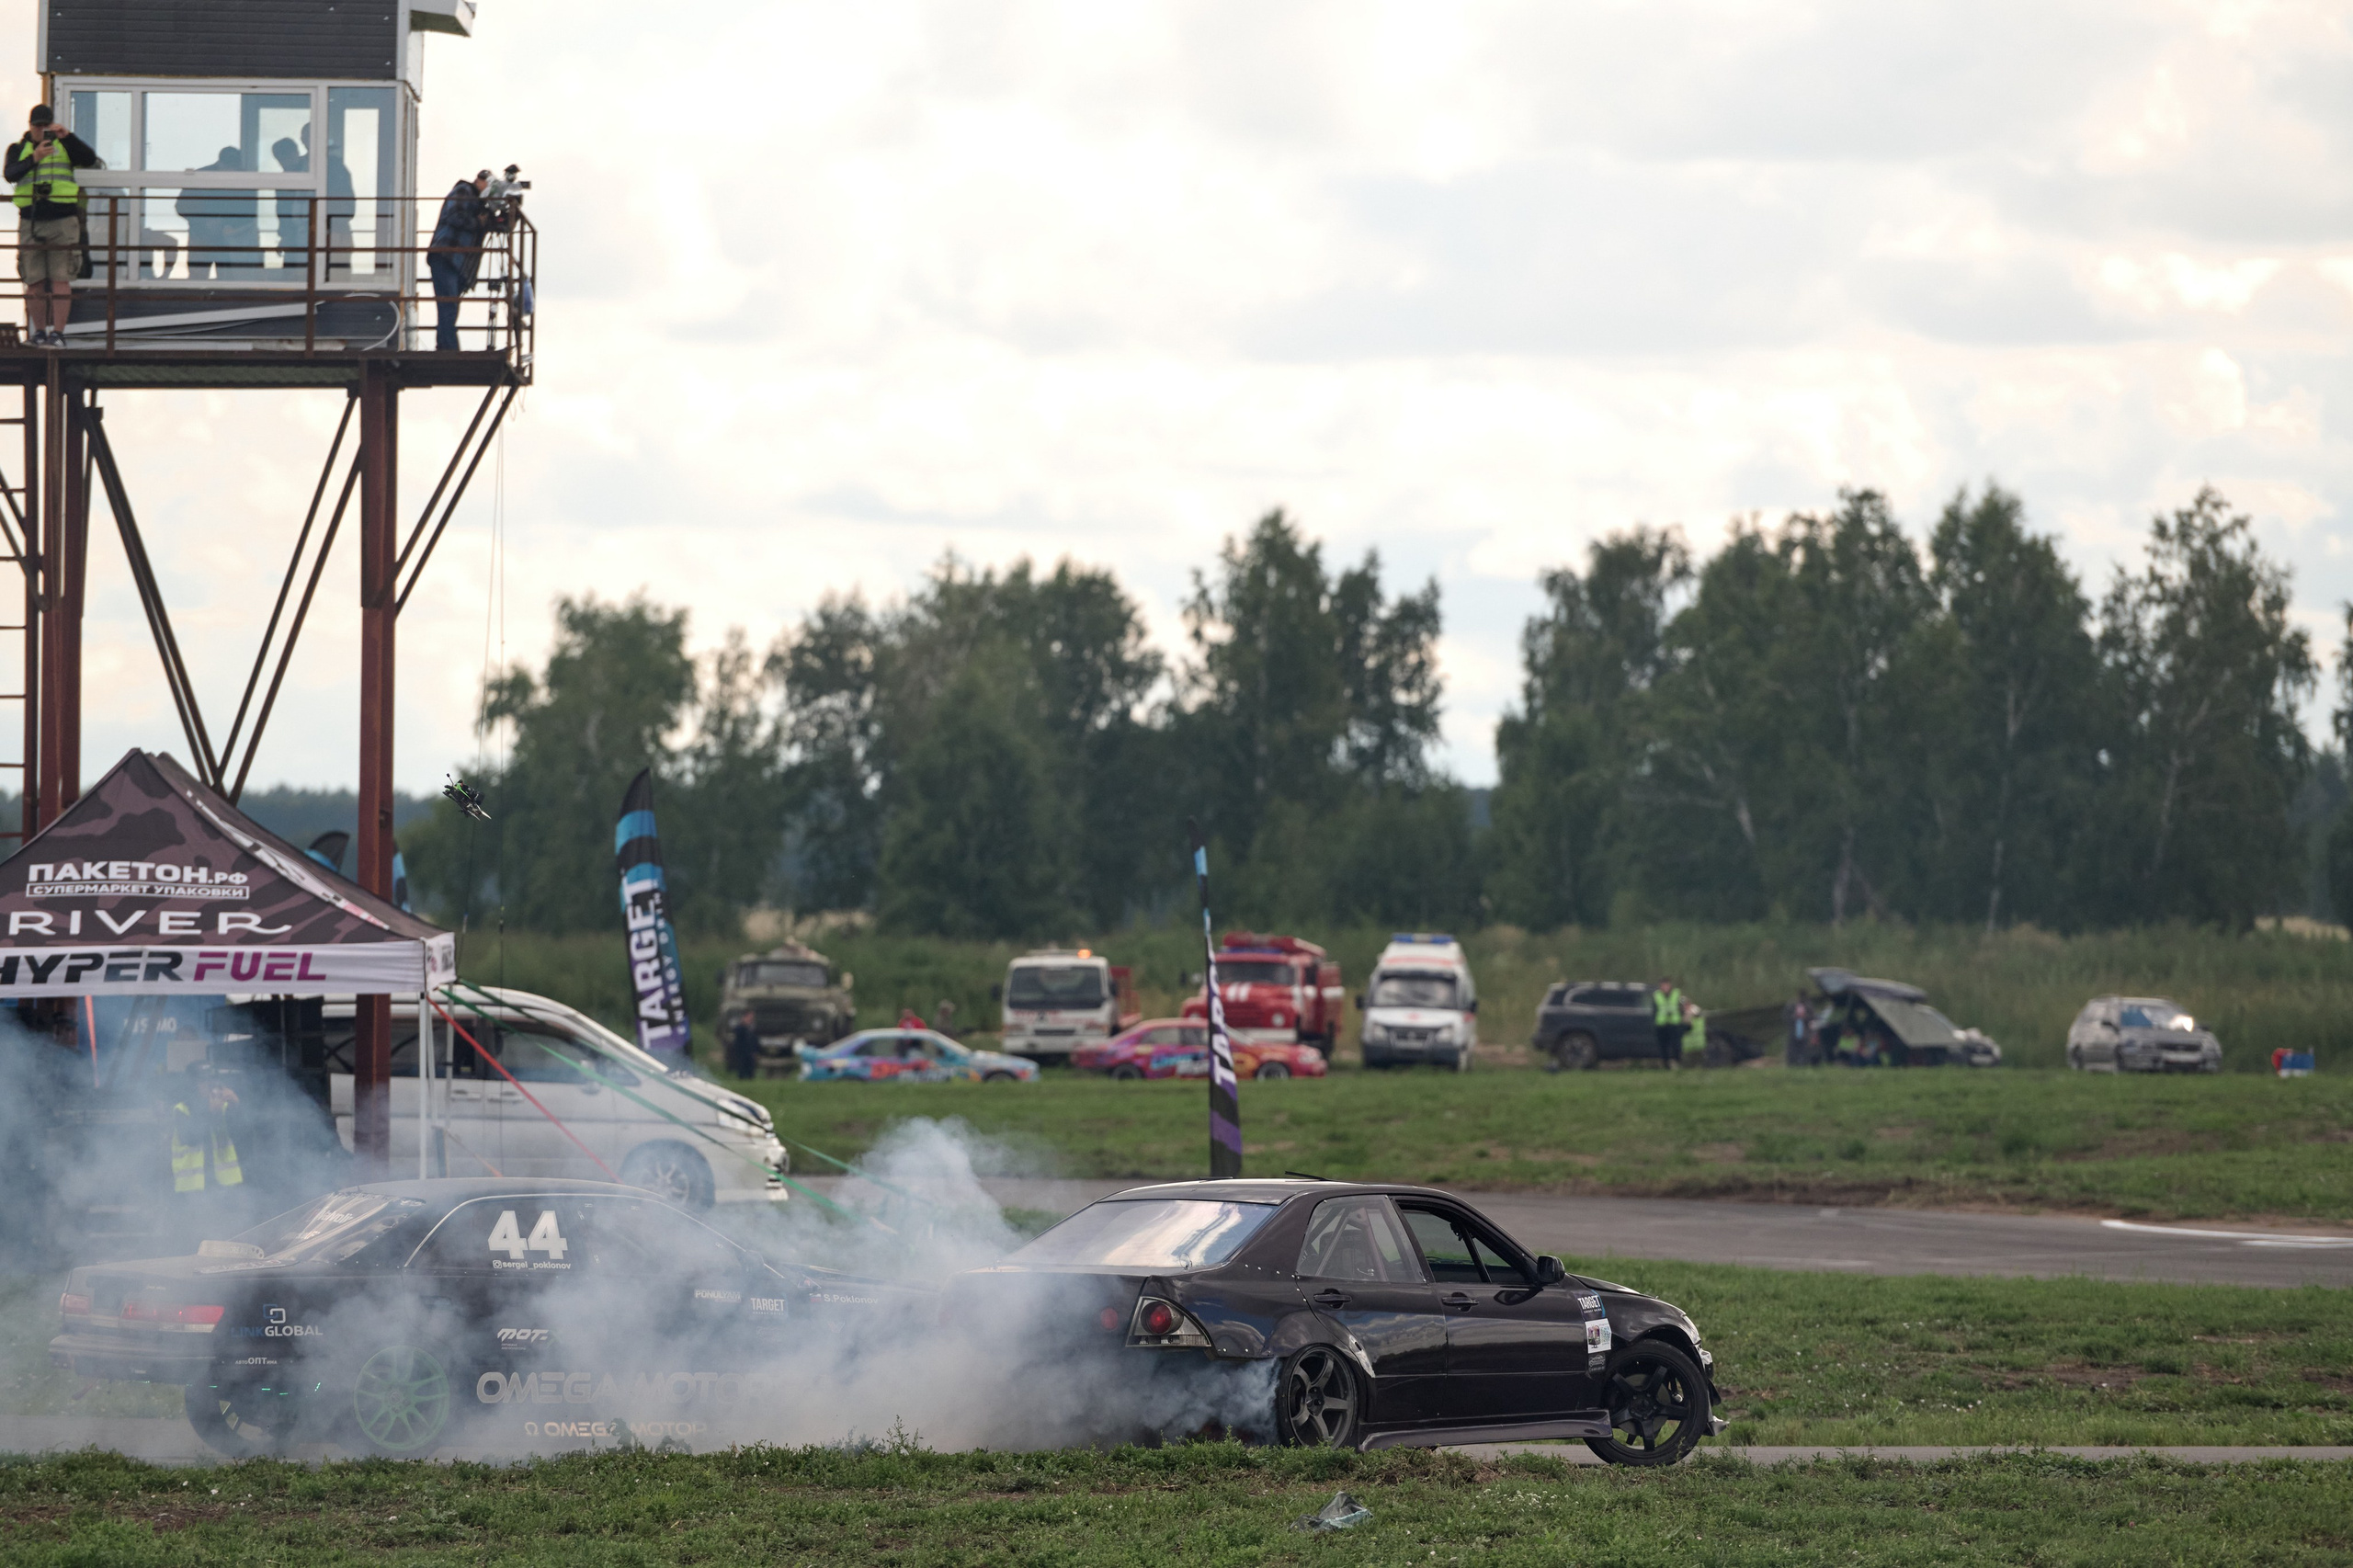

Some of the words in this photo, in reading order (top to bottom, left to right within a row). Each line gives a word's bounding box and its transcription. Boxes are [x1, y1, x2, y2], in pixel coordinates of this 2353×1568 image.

[33, 883, 149, 895] СУПЕРМАРКЕТ
[154, 884, 244, 897] УПАКОВКИ
[193, 950, 327, 983] FUEL
[620, 876, 673, 1051] TARGET
[487, 1210, 569, 1260] 44
[750, 1297, 786, 1312] TARGET
[476, 1370, 618, 1403] OMEGA
